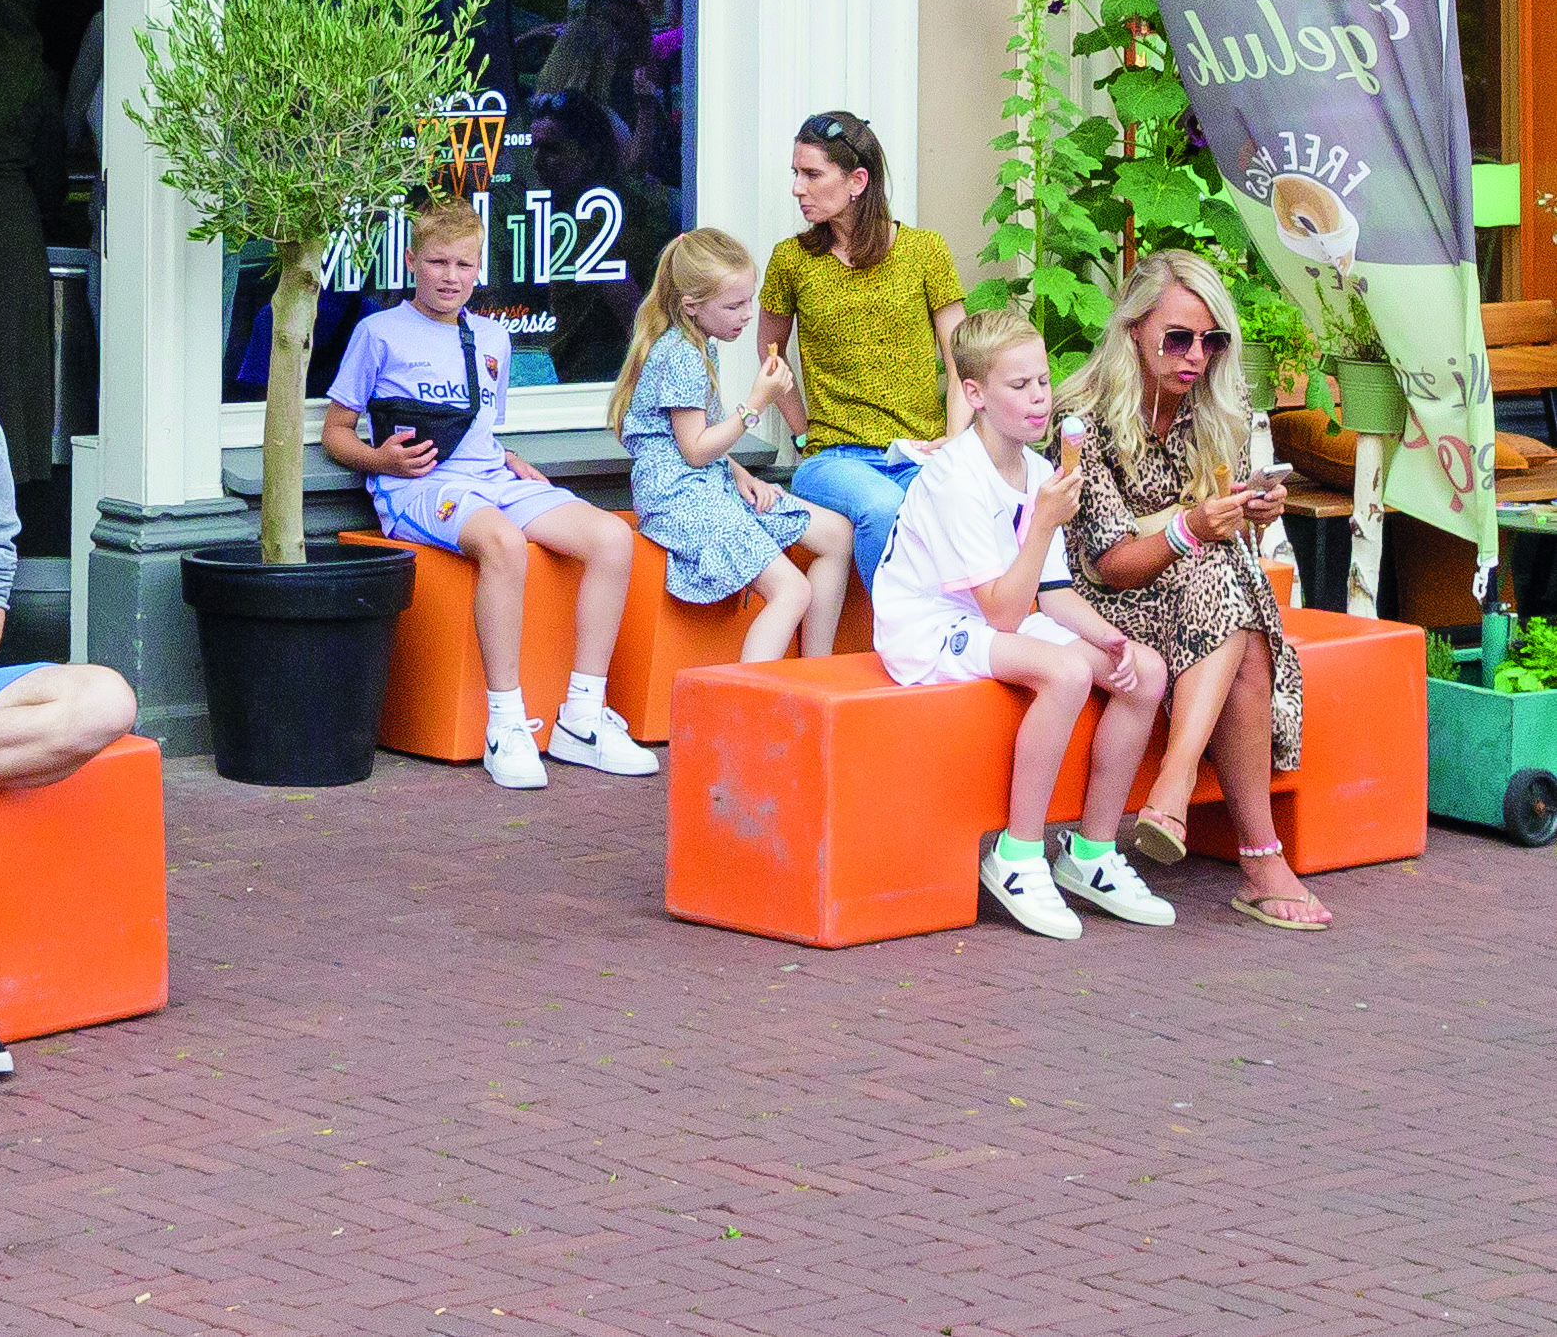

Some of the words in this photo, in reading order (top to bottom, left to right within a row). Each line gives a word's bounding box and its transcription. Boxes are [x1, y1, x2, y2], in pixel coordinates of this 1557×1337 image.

[504, 133, 533, 147] 2005
[525, 187, 627, 286] 12
[417, 380, 498, 409] Rakuen
